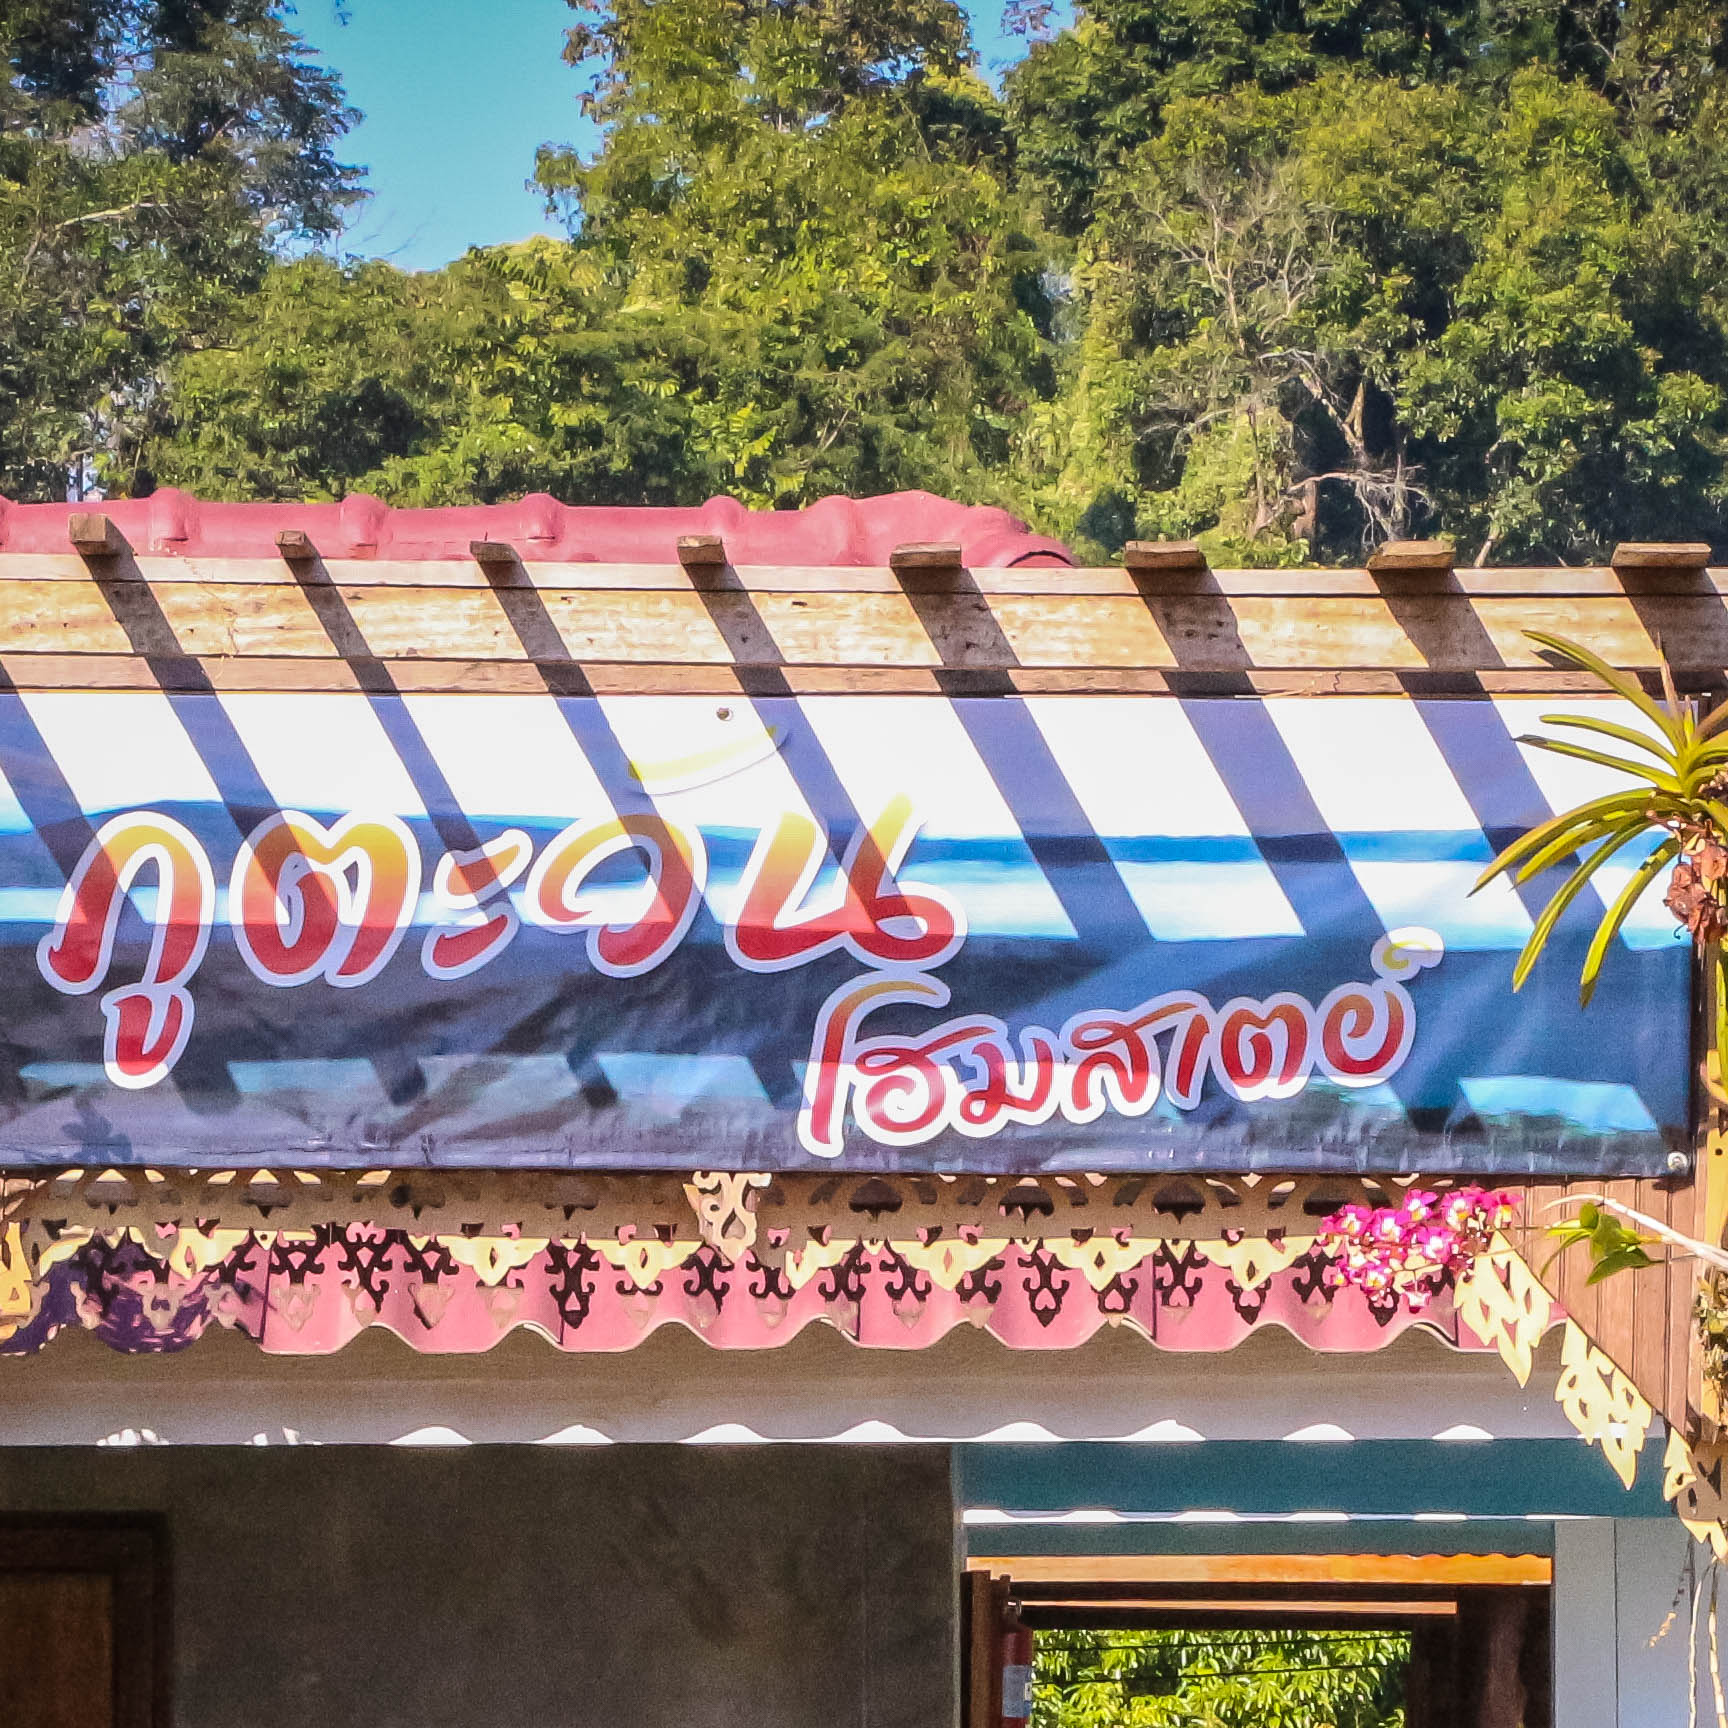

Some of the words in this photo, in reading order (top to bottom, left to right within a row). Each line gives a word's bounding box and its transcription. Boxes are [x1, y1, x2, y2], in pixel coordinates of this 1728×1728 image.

[38, 724, 967, 1087] ภูตะวัน
[798, 928, 1443, 1156] โฮมสเตย์
